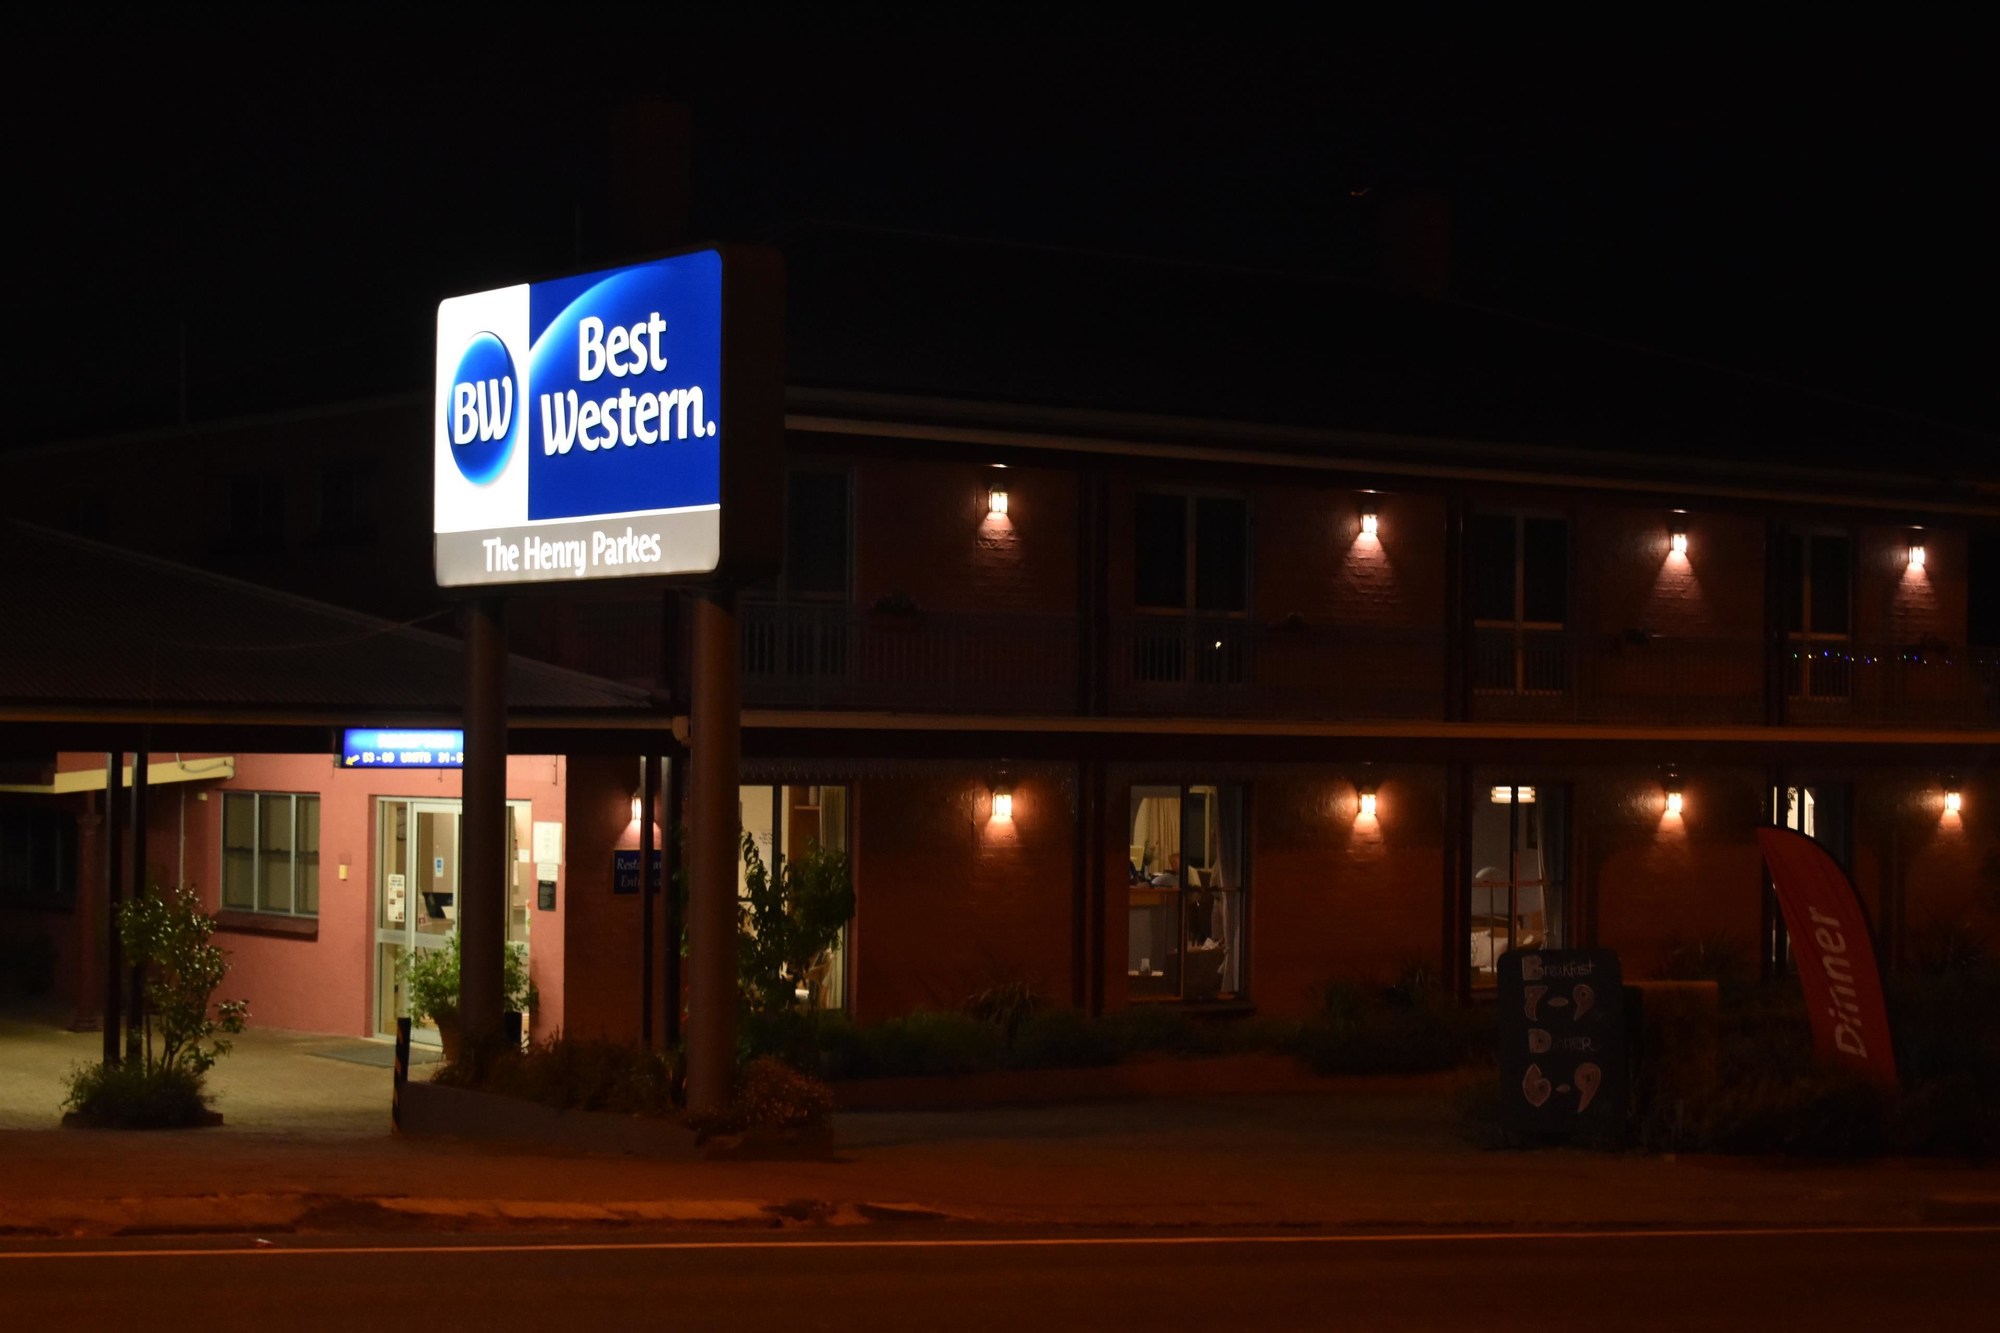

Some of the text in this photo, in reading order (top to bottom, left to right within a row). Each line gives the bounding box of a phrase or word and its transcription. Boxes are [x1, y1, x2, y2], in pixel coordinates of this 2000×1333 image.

[579, 312, 668, 382] Best
[454, 376, 512, 445] BW
[483, 527, 662, 576] The Henry Parkes
[1809, 906, 1867, 1059] Dinner
